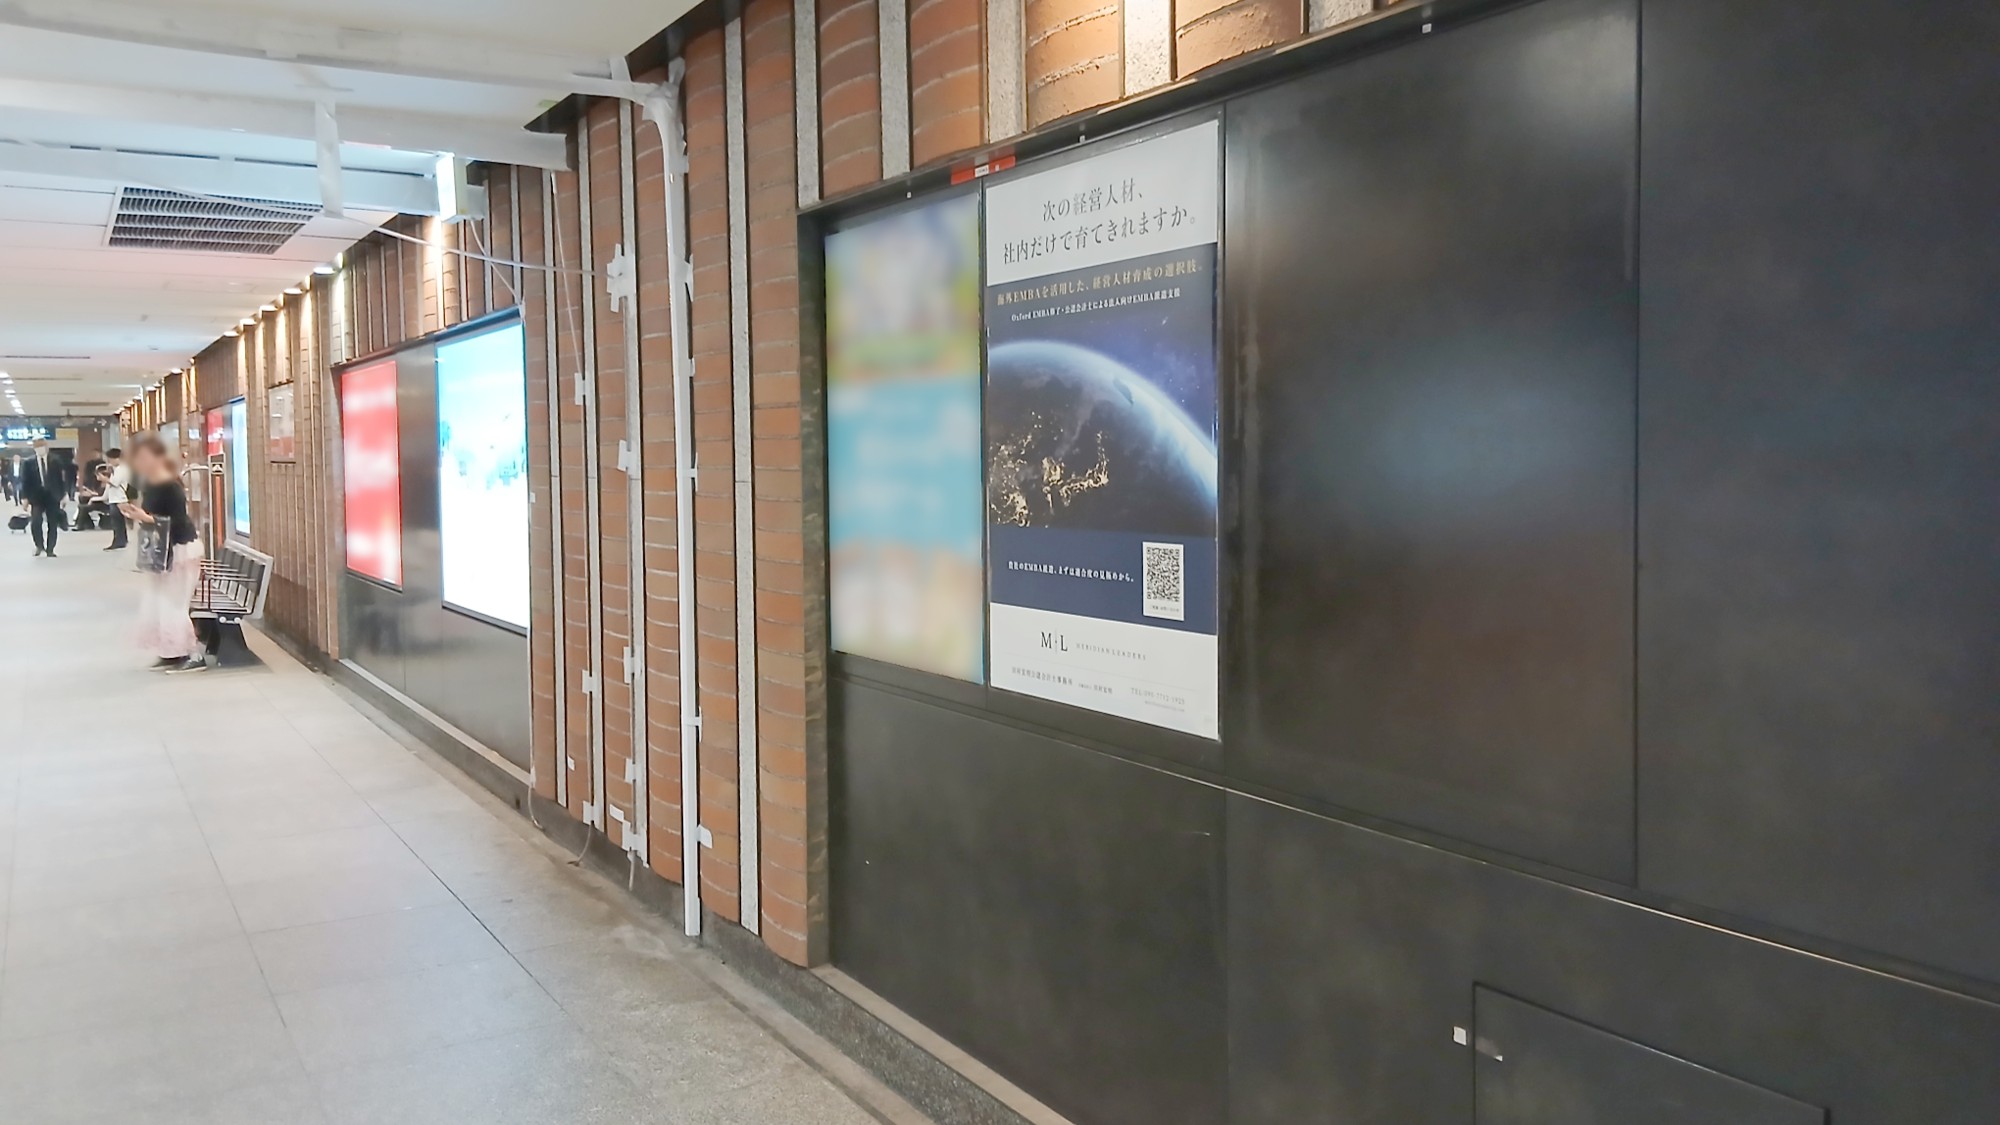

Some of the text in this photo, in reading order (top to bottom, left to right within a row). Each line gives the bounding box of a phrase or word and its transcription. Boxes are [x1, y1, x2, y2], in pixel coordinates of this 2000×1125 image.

[1043, 177, 1143, 222] 次の経営人材、
[1003, 205, 1196, 265] 社内だけで育てきれますか。
[1011, 310, 1032, 322] Oxford
